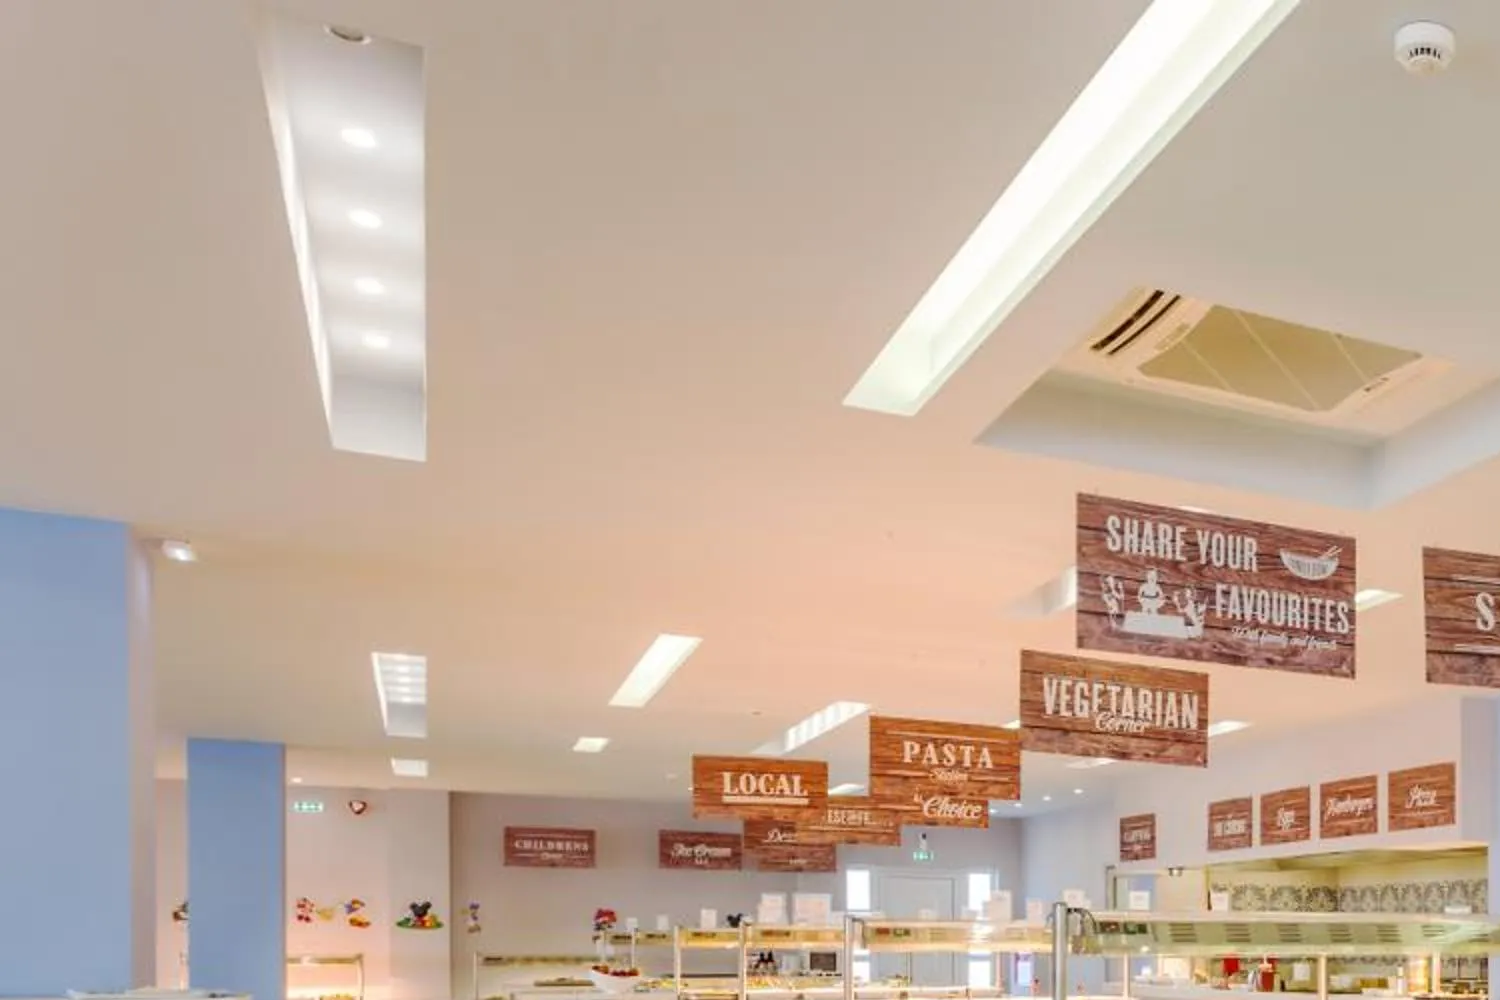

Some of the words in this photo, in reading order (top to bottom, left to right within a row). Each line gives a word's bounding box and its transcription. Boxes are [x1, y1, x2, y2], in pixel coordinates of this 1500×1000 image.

[1105, 515, 1187, 562] SHARE
[1196, 529, 1259, 573] YOUR
[1215, 583, 1351, 635] FAVOURITES
[1043, 677, 1199, 729] VEGETARIAN
[1095, 711, 1149, 734] Corner
[903, 740, 993, 769] PASTA
[722, 771, 808, 796] LOCAL
[923, 796, 983, 819] Choice
